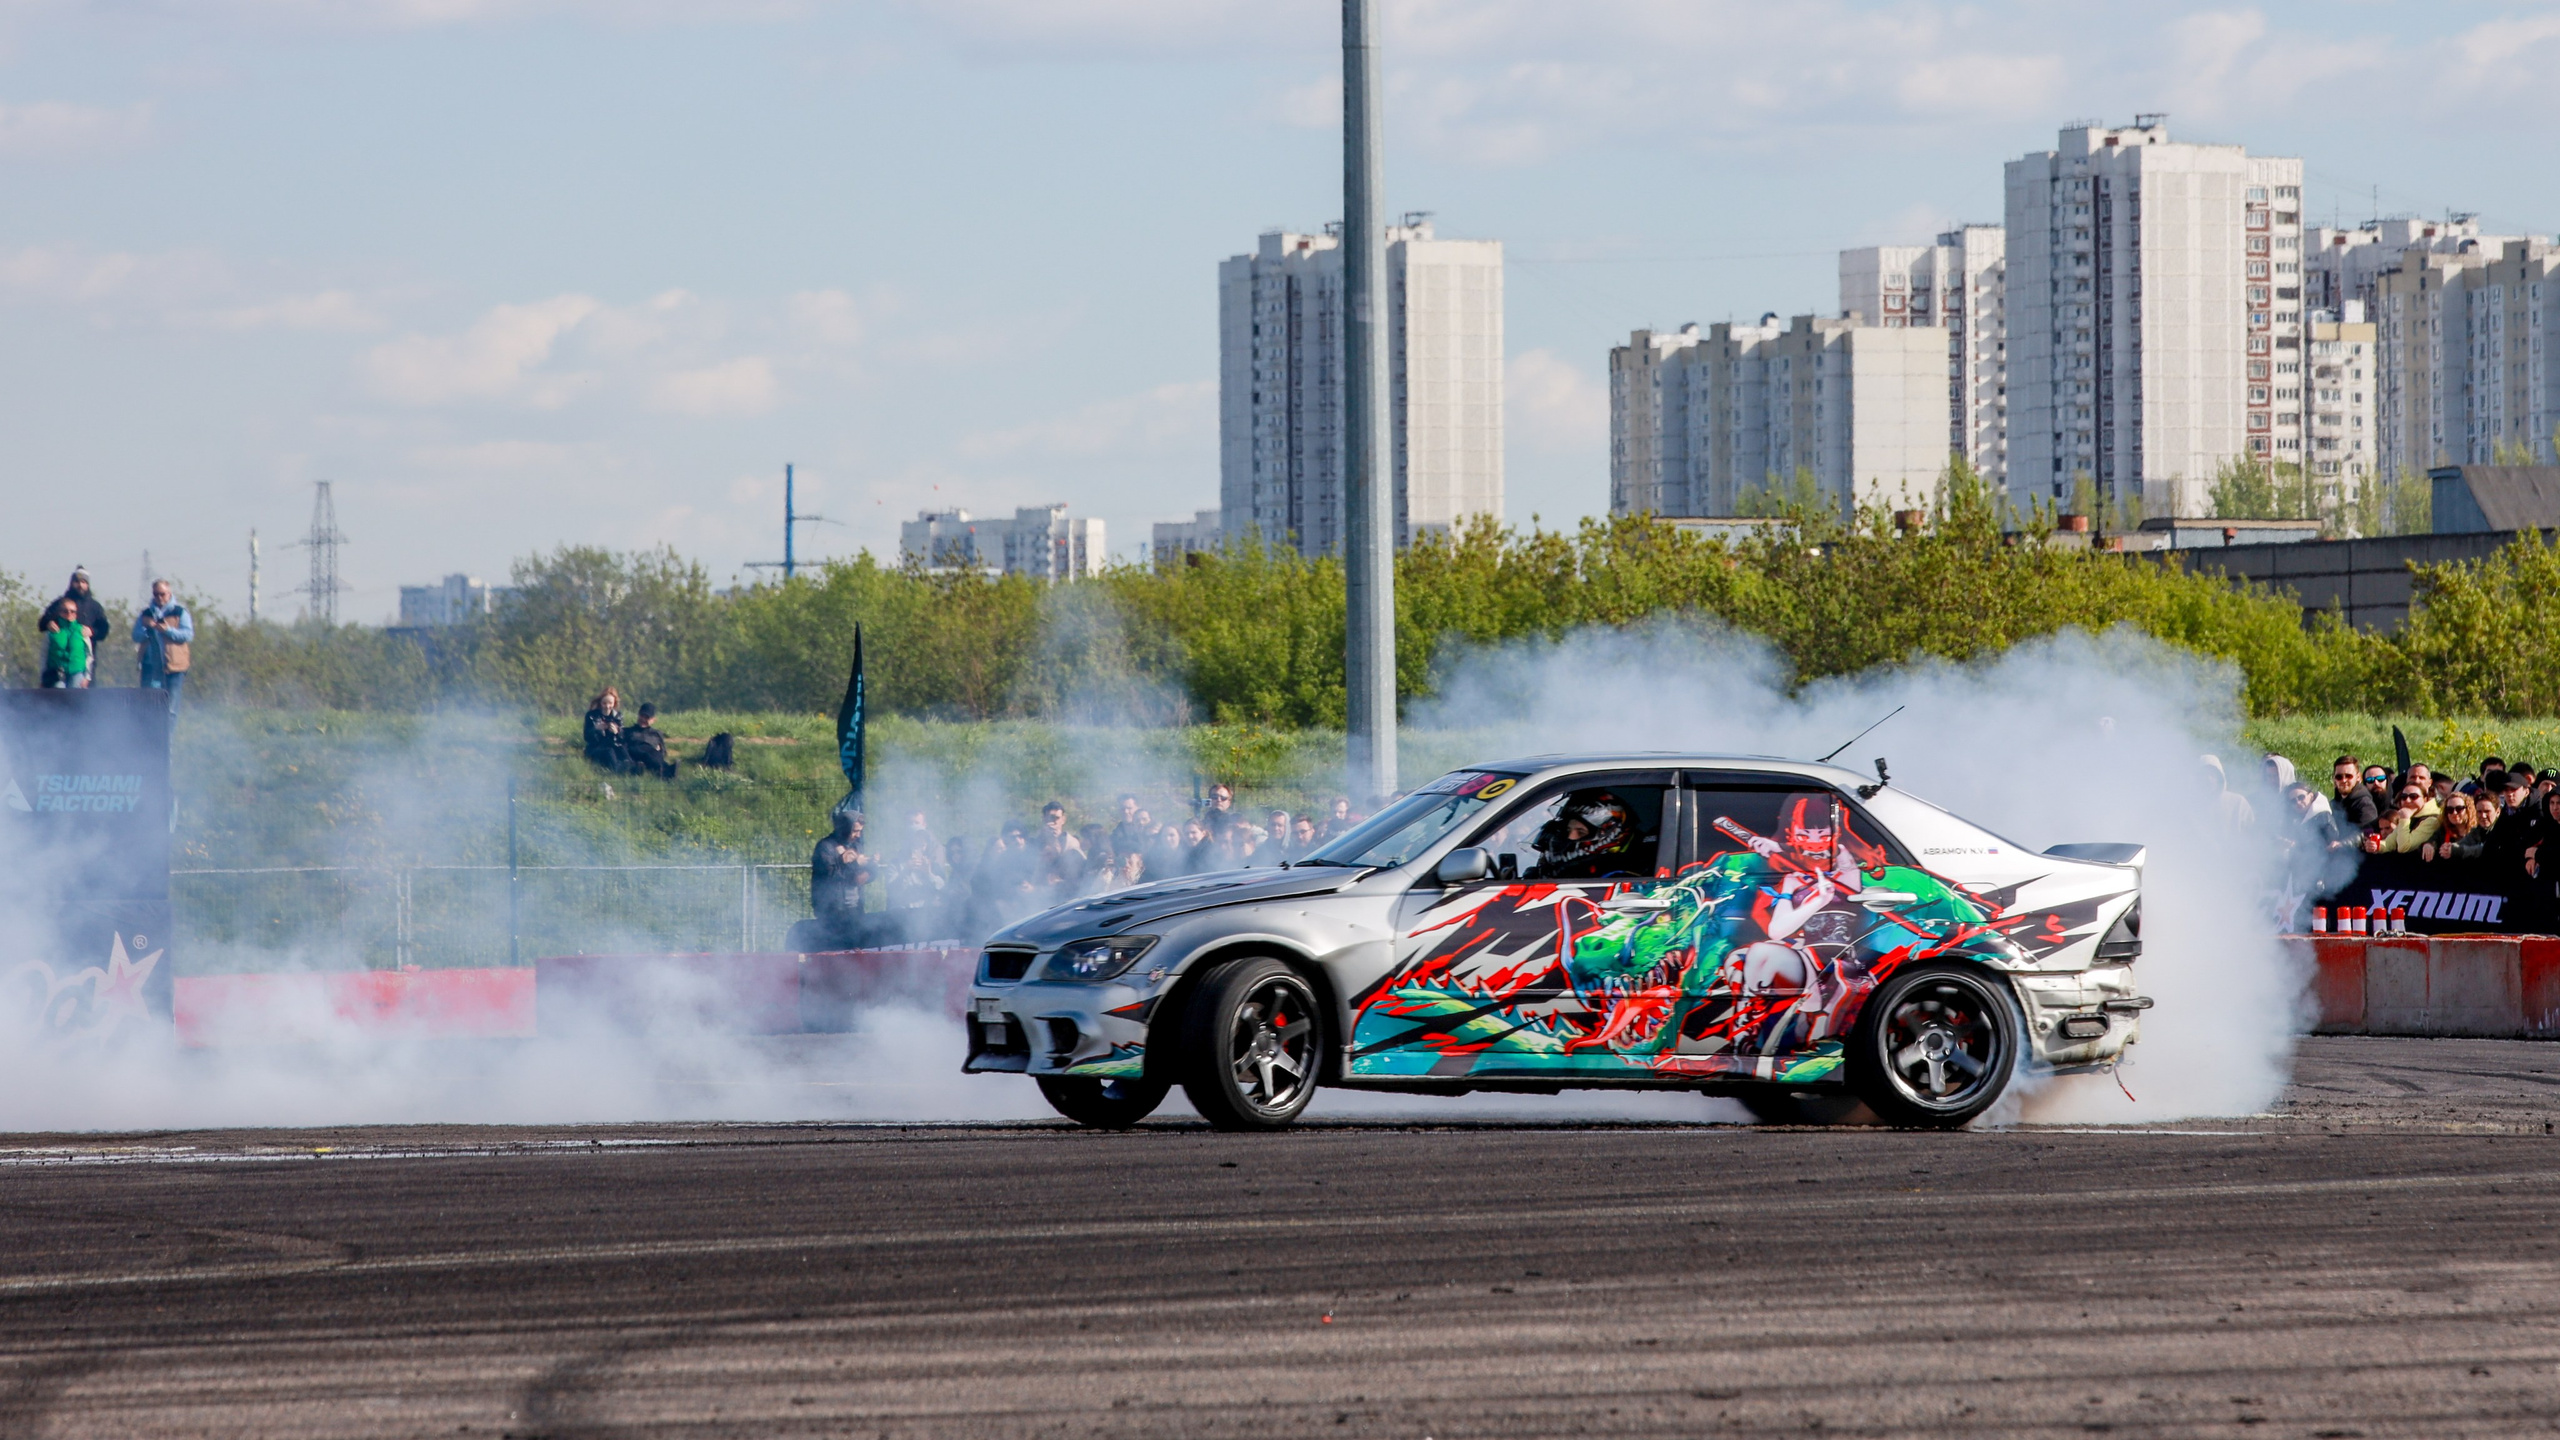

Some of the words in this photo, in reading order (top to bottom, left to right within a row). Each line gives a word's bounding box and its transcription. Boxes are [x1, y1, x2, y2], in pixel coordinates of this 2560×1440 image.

[36, 774, 143, 792] TSUNAMI
[36, 795, 140, 812] FACTORY
[1923, 847, 1967, 855] ABRAMOV
